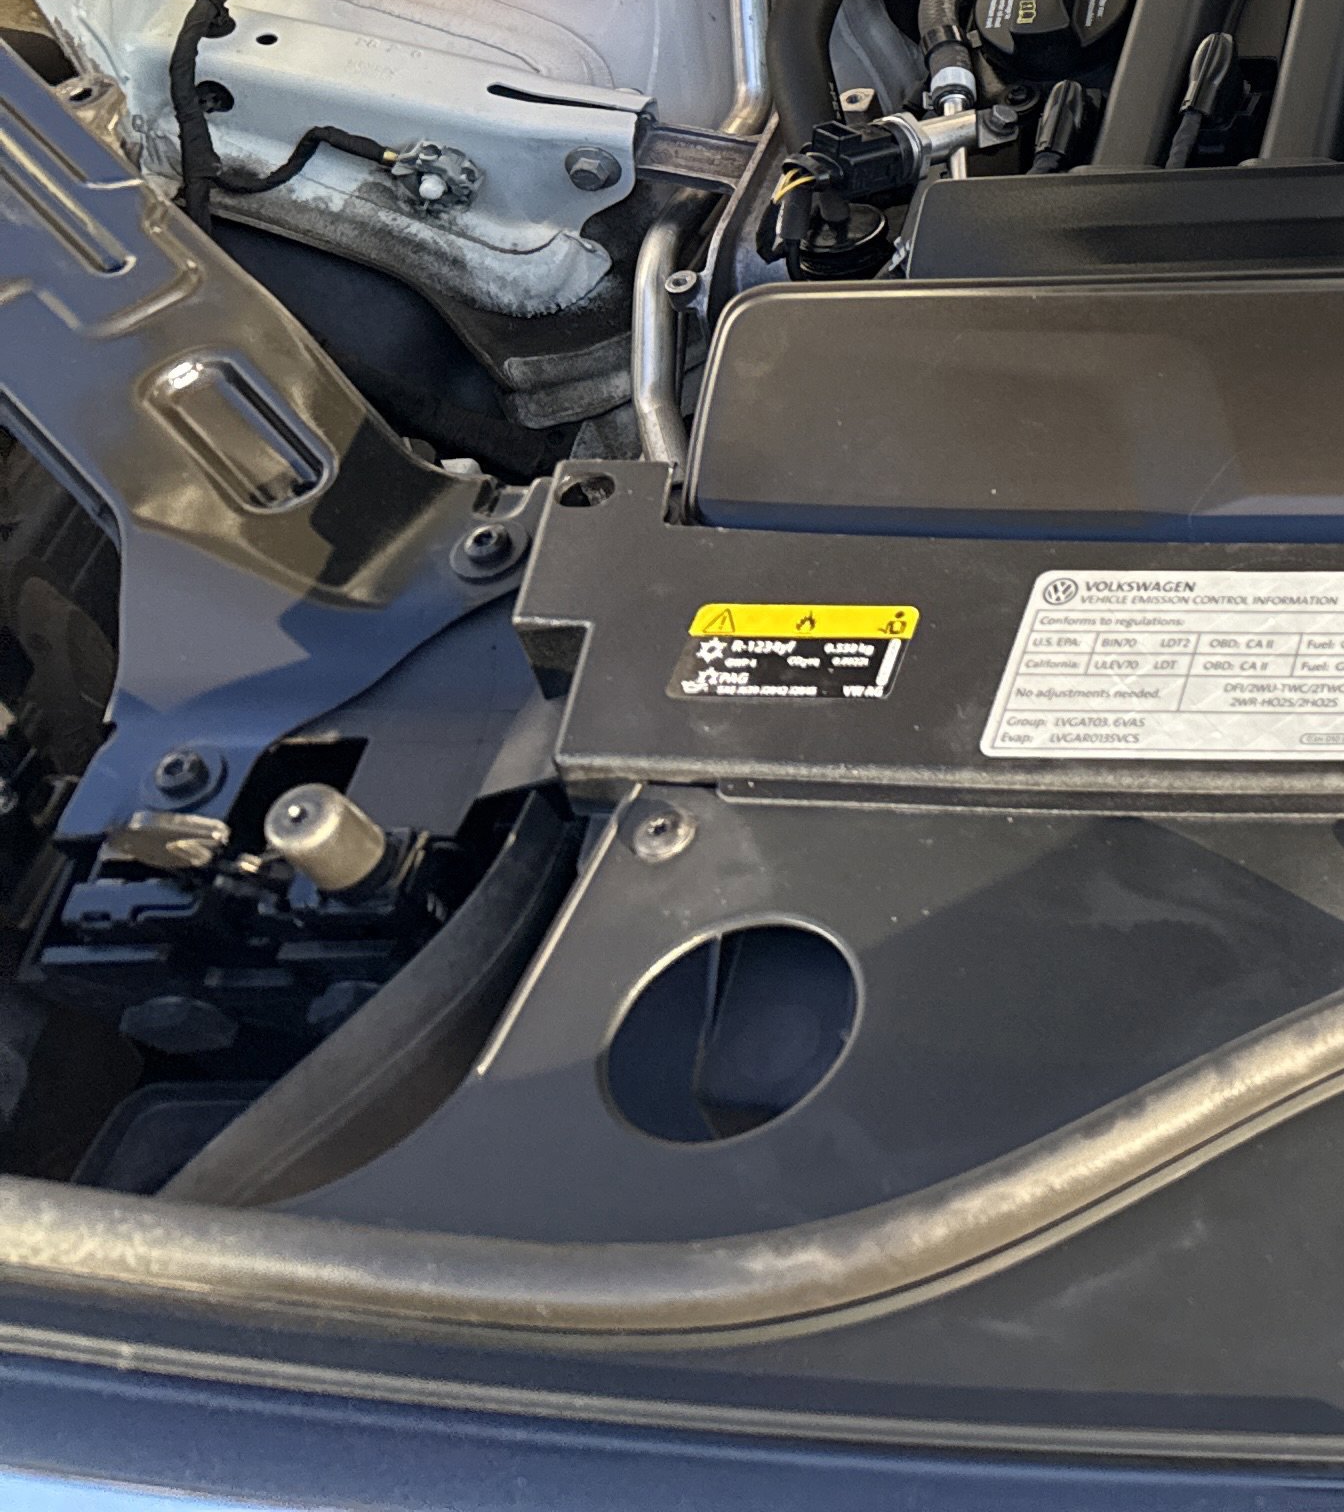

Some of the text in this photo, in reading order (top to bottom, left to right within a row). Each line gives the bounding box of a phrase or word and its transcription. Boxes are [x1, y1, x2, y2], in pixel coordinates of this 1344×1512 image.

[1085, 581, 1196, 592] VOLKSWAGEN
[1081, 595, 1338, 605] VEHICLE EMISSION CONTROL INFORMATION
[1040, 616, 1184, 628] Conforms to regulations:
[1032, 638, 1052, 647] U.S.
[1101, 638, 1190, 648] BIN70 LDT2
[1209, 639, 1240, 649] OBD:
[1245, 639, 1264, 649] CA
[1306, 640, 1334, 650] Fuel:
[1025, 659, 1080, 669] California:
[1153, 660, 1178, 670] LDT
[1203, 661, 1234, 671] OBD:
[1240, 661, 1258, 671] CA
[1301, 662, 1330, 671] Fuel:
[1016, 688, 1160, 700] No adjustments needed.
[1006, 716, 1048, 729] Group:
